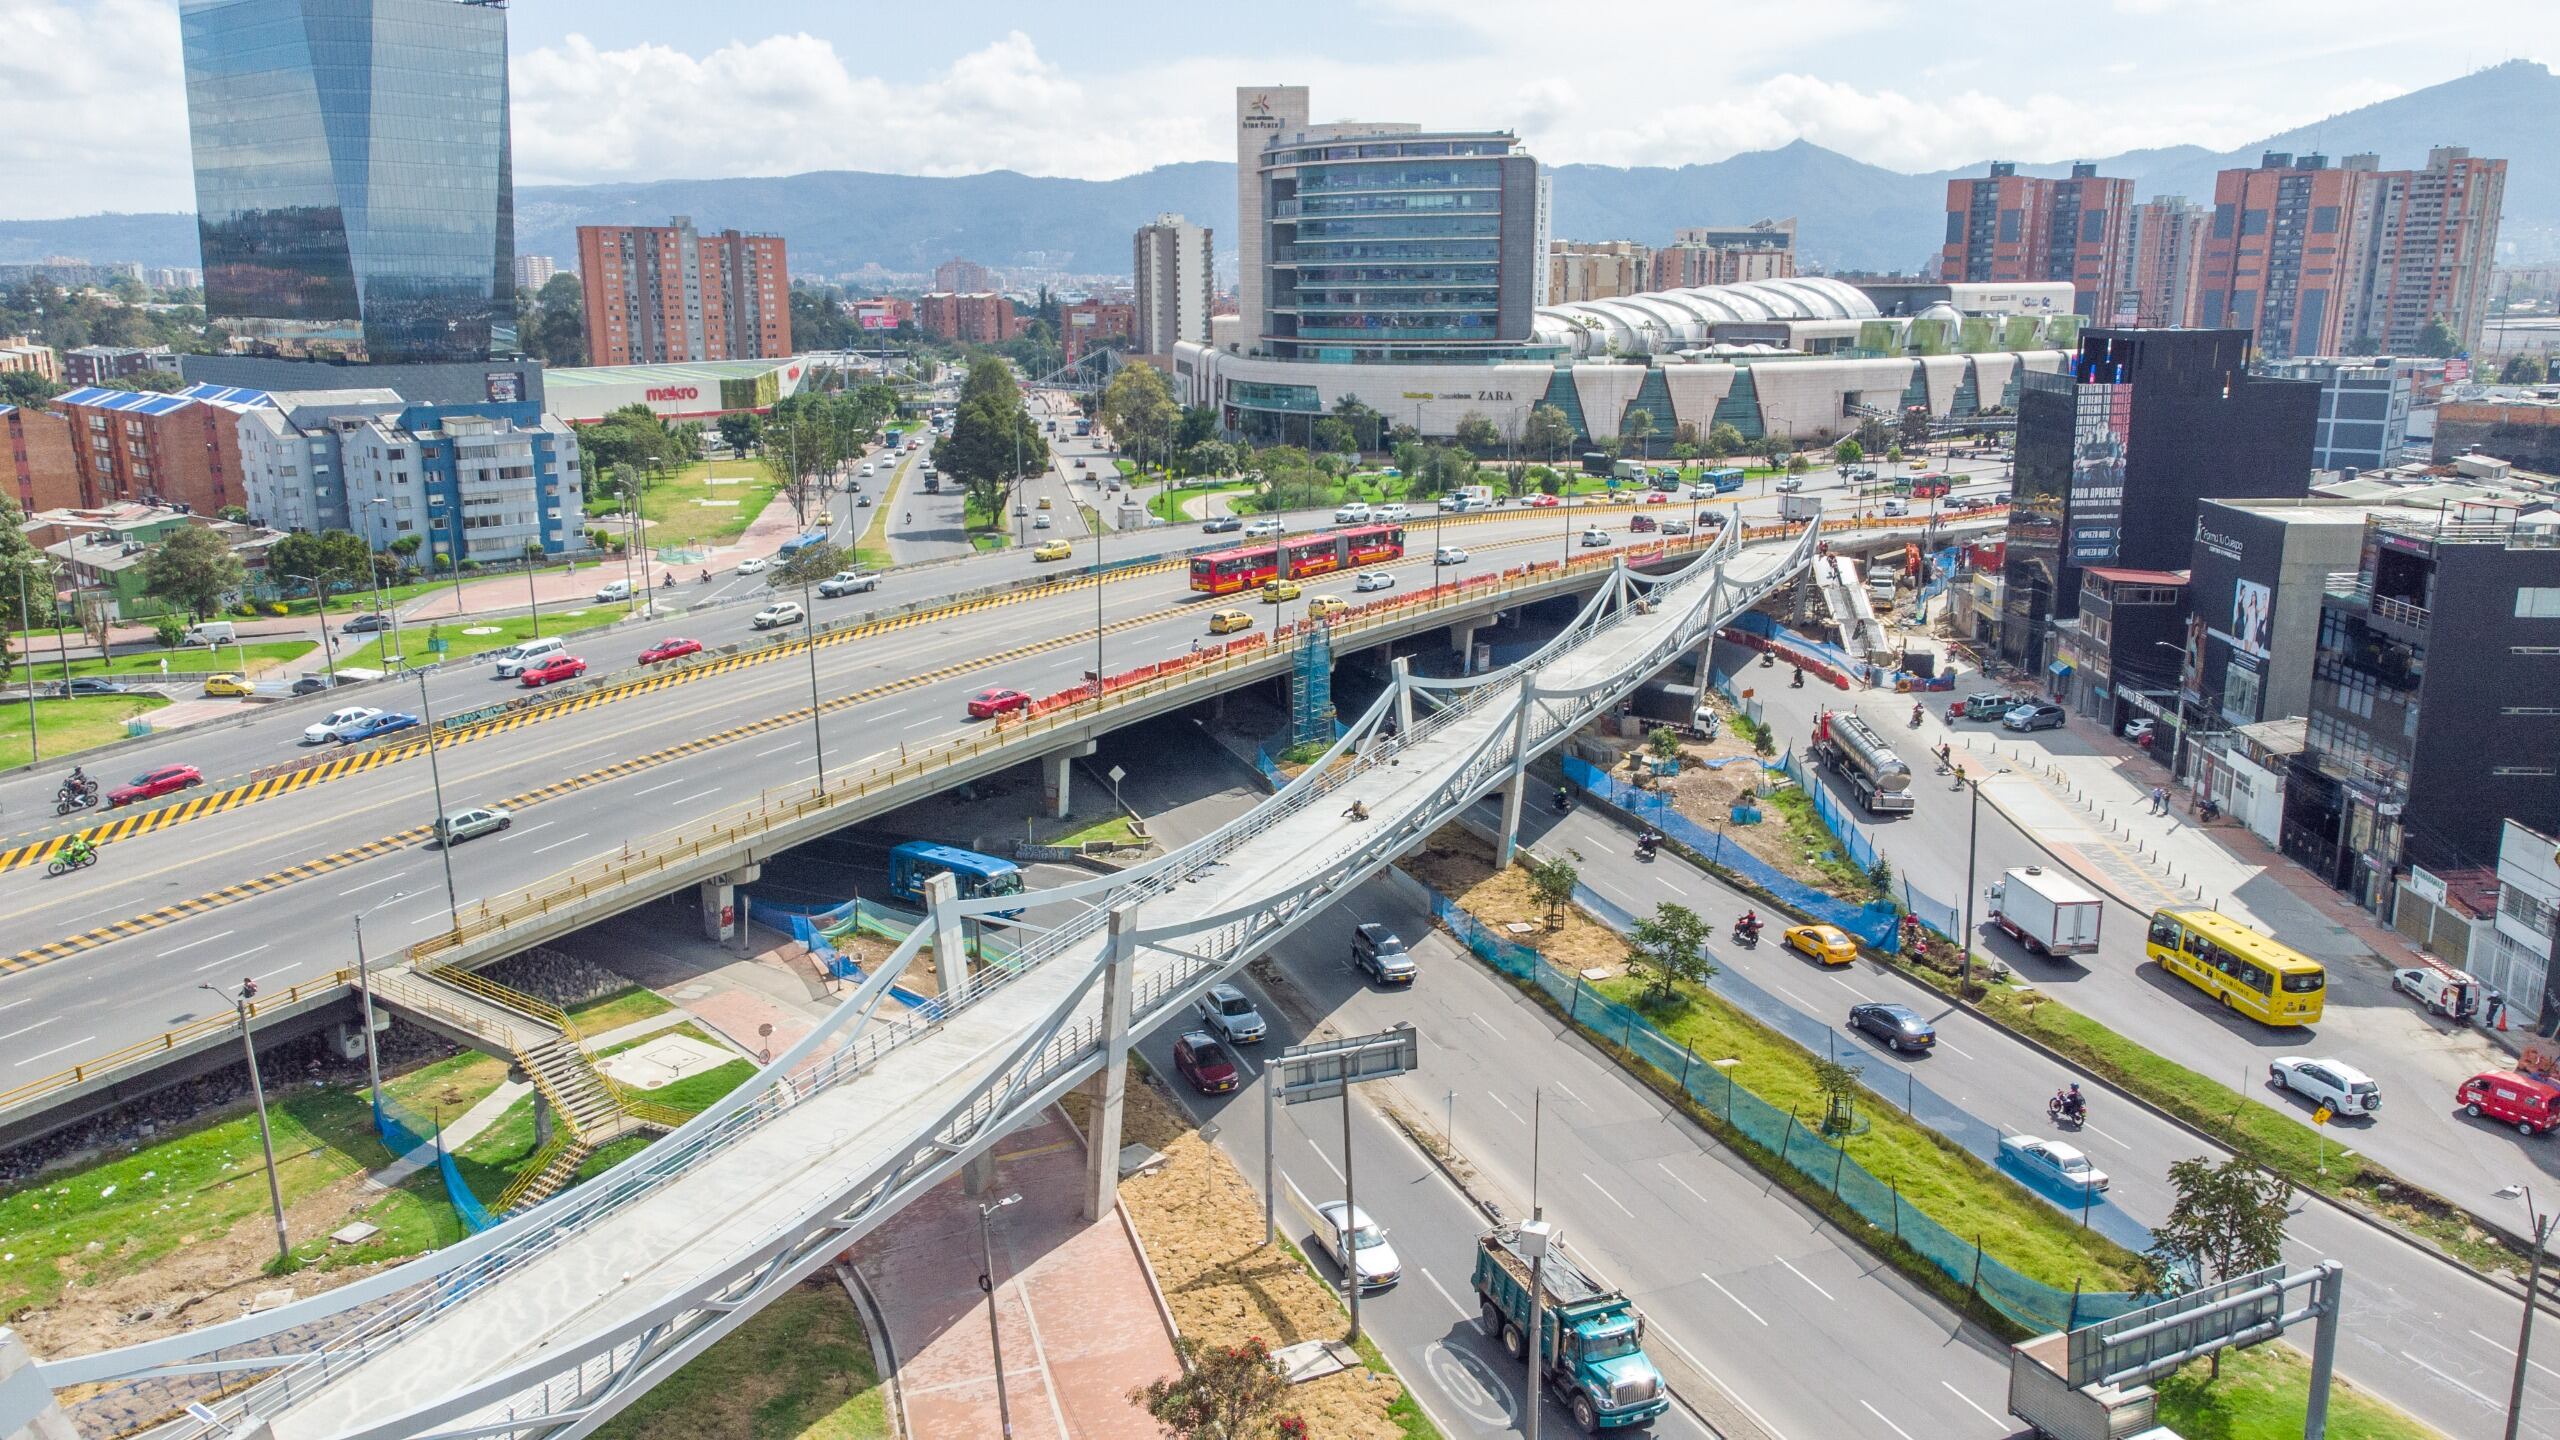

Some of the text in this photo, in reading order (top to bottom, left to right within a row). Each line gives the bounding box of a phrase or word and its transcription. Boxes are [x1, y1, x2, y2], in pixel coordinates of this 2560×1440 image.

[646, 385, 699, 401] makro
[1478, 391, 1512, 400] ZARA
[2071, 487, 2088, 499] PARA
[2118, 685, 2160, 718] PUNTO DE VENTA
